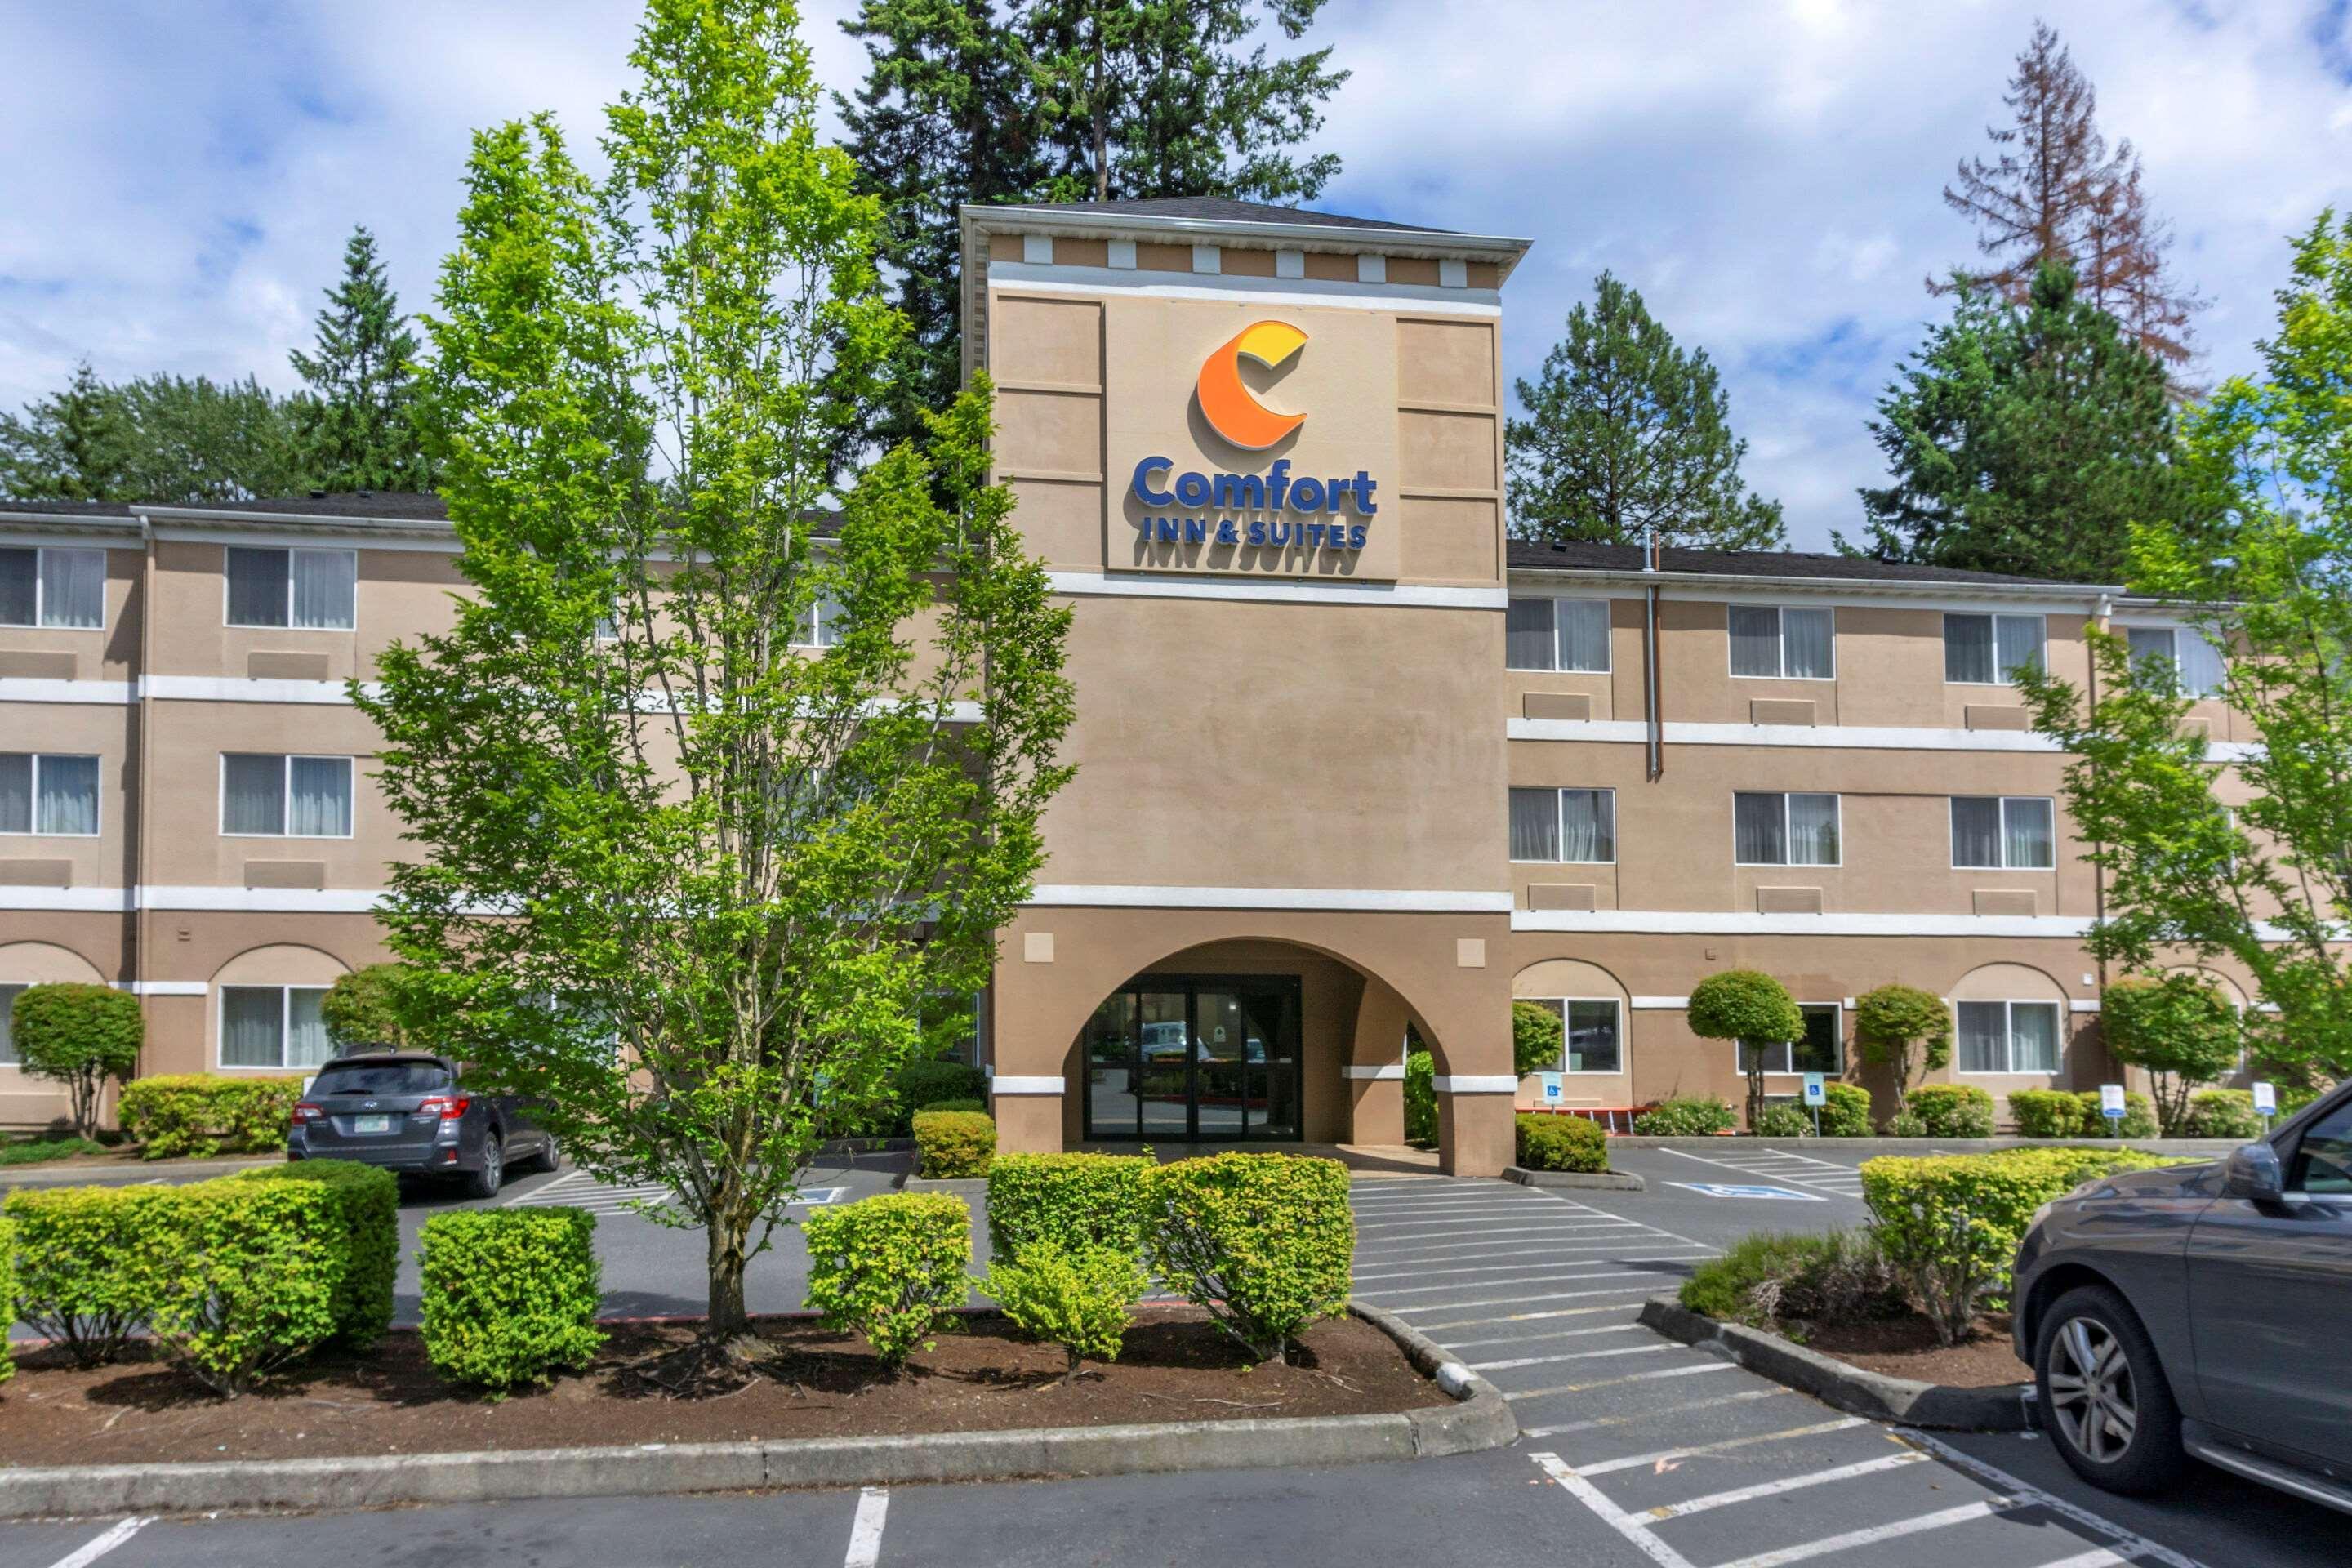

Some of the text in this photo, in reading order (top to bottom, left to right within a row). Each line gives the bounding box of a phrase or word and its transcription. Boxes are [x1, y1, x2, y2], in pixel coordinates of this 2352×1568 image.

[1134, 456, 1378, 515] Comfort
[1143, 516, 1367, 550] INN & SUITES
